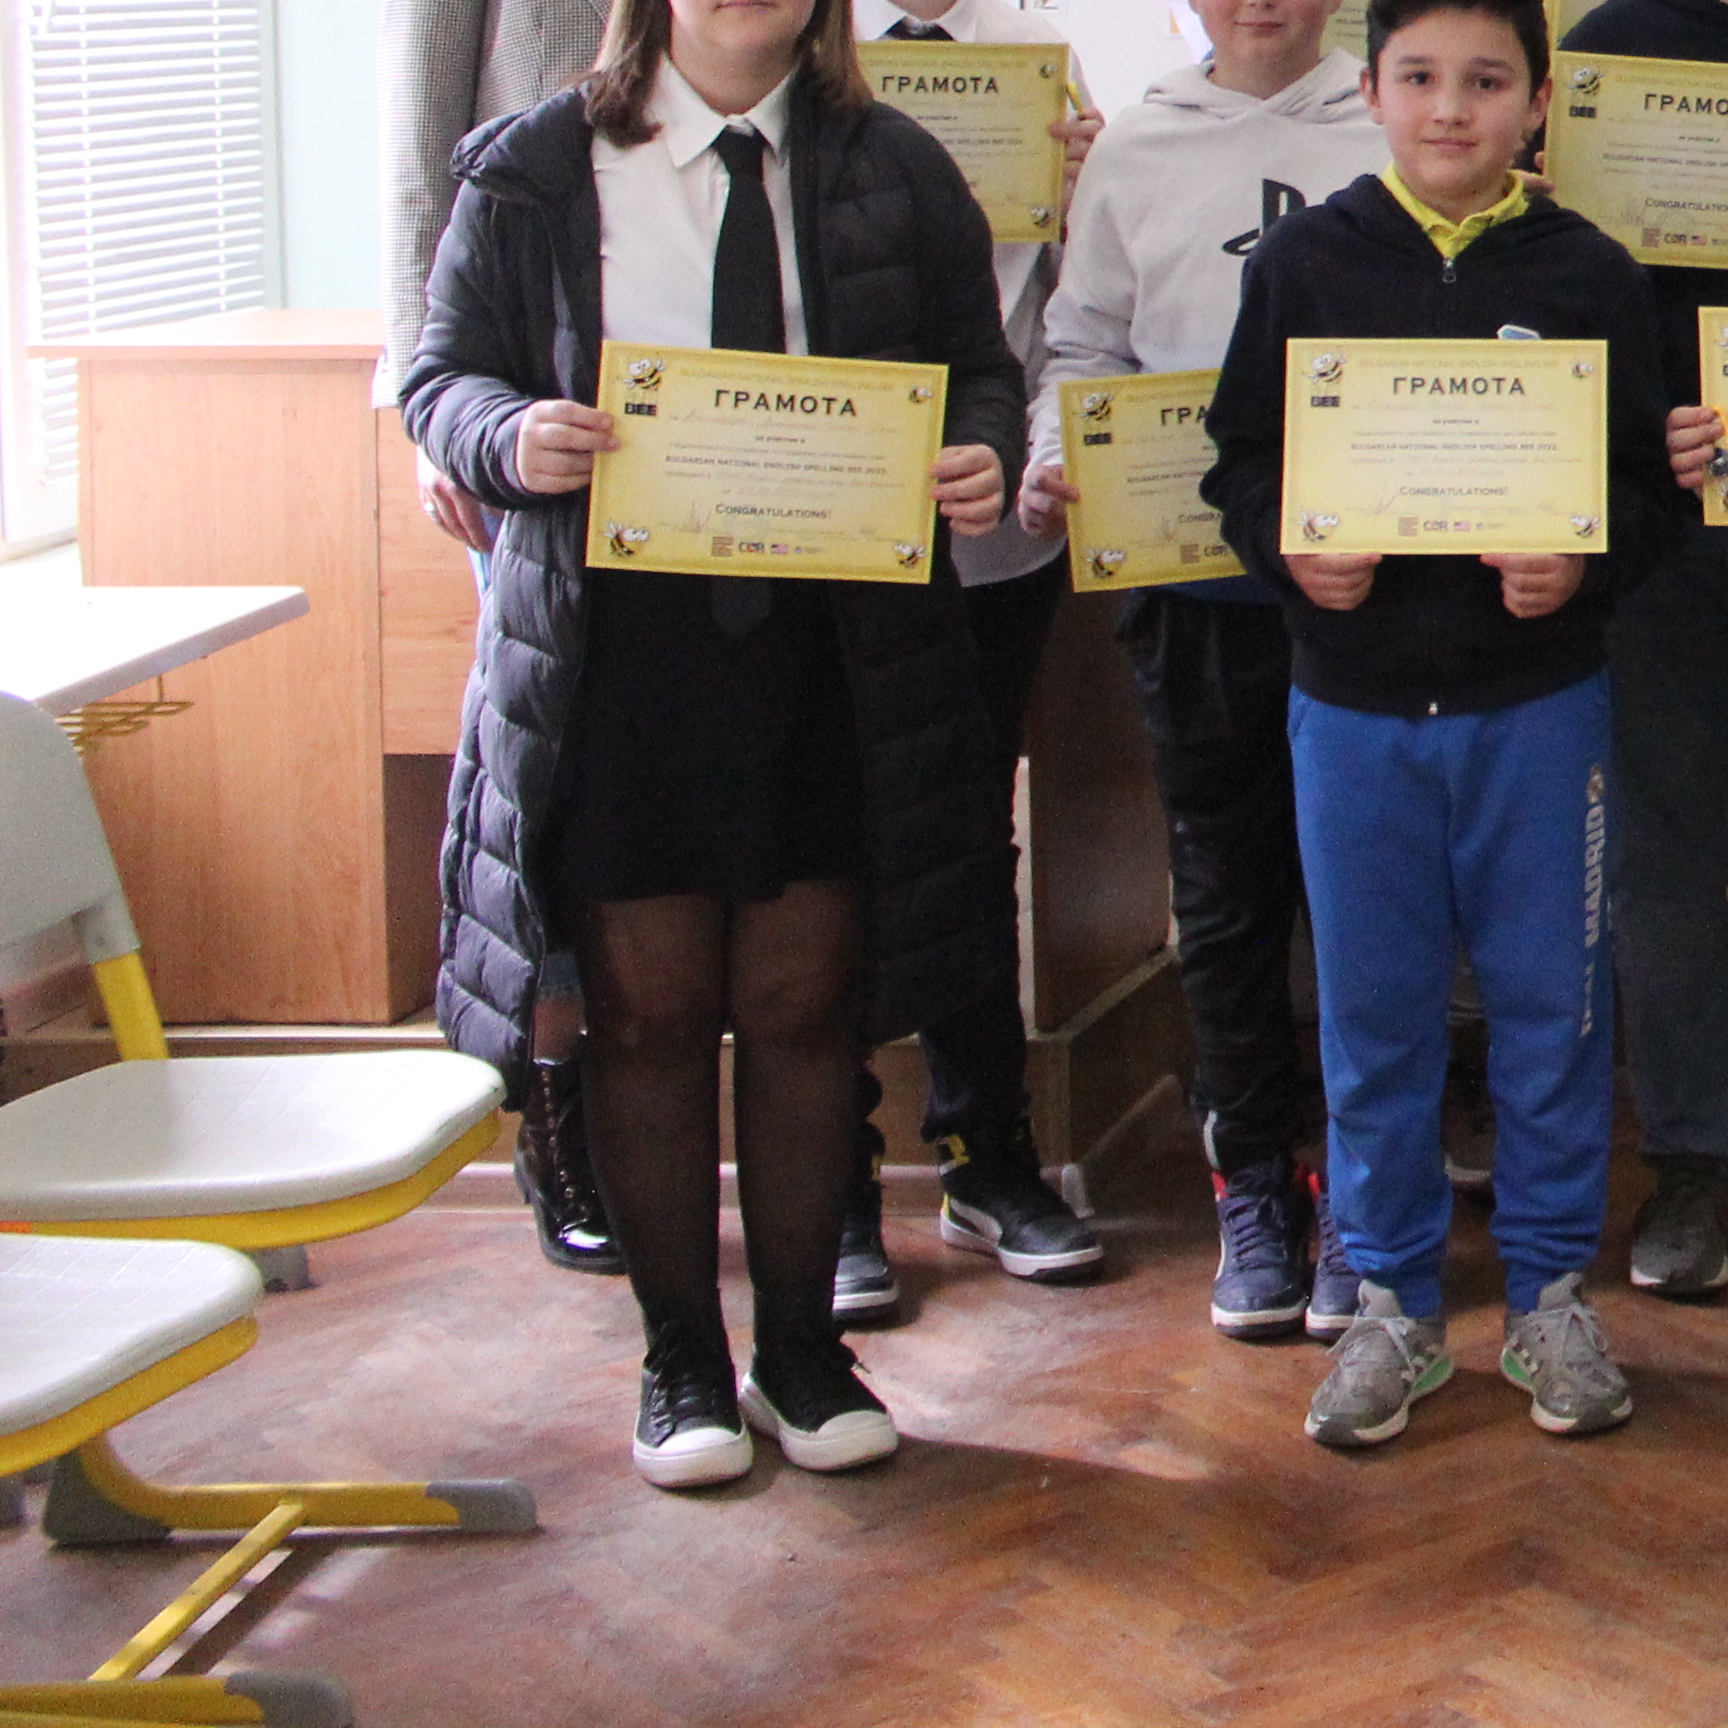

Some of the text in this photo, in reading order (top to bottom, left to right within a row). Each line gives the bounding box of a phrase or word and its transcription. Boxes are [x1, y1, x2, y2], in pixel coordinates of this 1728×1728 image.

[881, 75, 999, 94] ГРАМОТА
[1393, 376, 1525, 396] ГРАМОТА
[624, 401, 657, 417] BEE
[713, 388, 858, 417] ГРАМОТА
[1399, 485, 1509, 497] CONGRATULATIONS!
[715, 503, 833, 520] CONGRATULATIONS!
